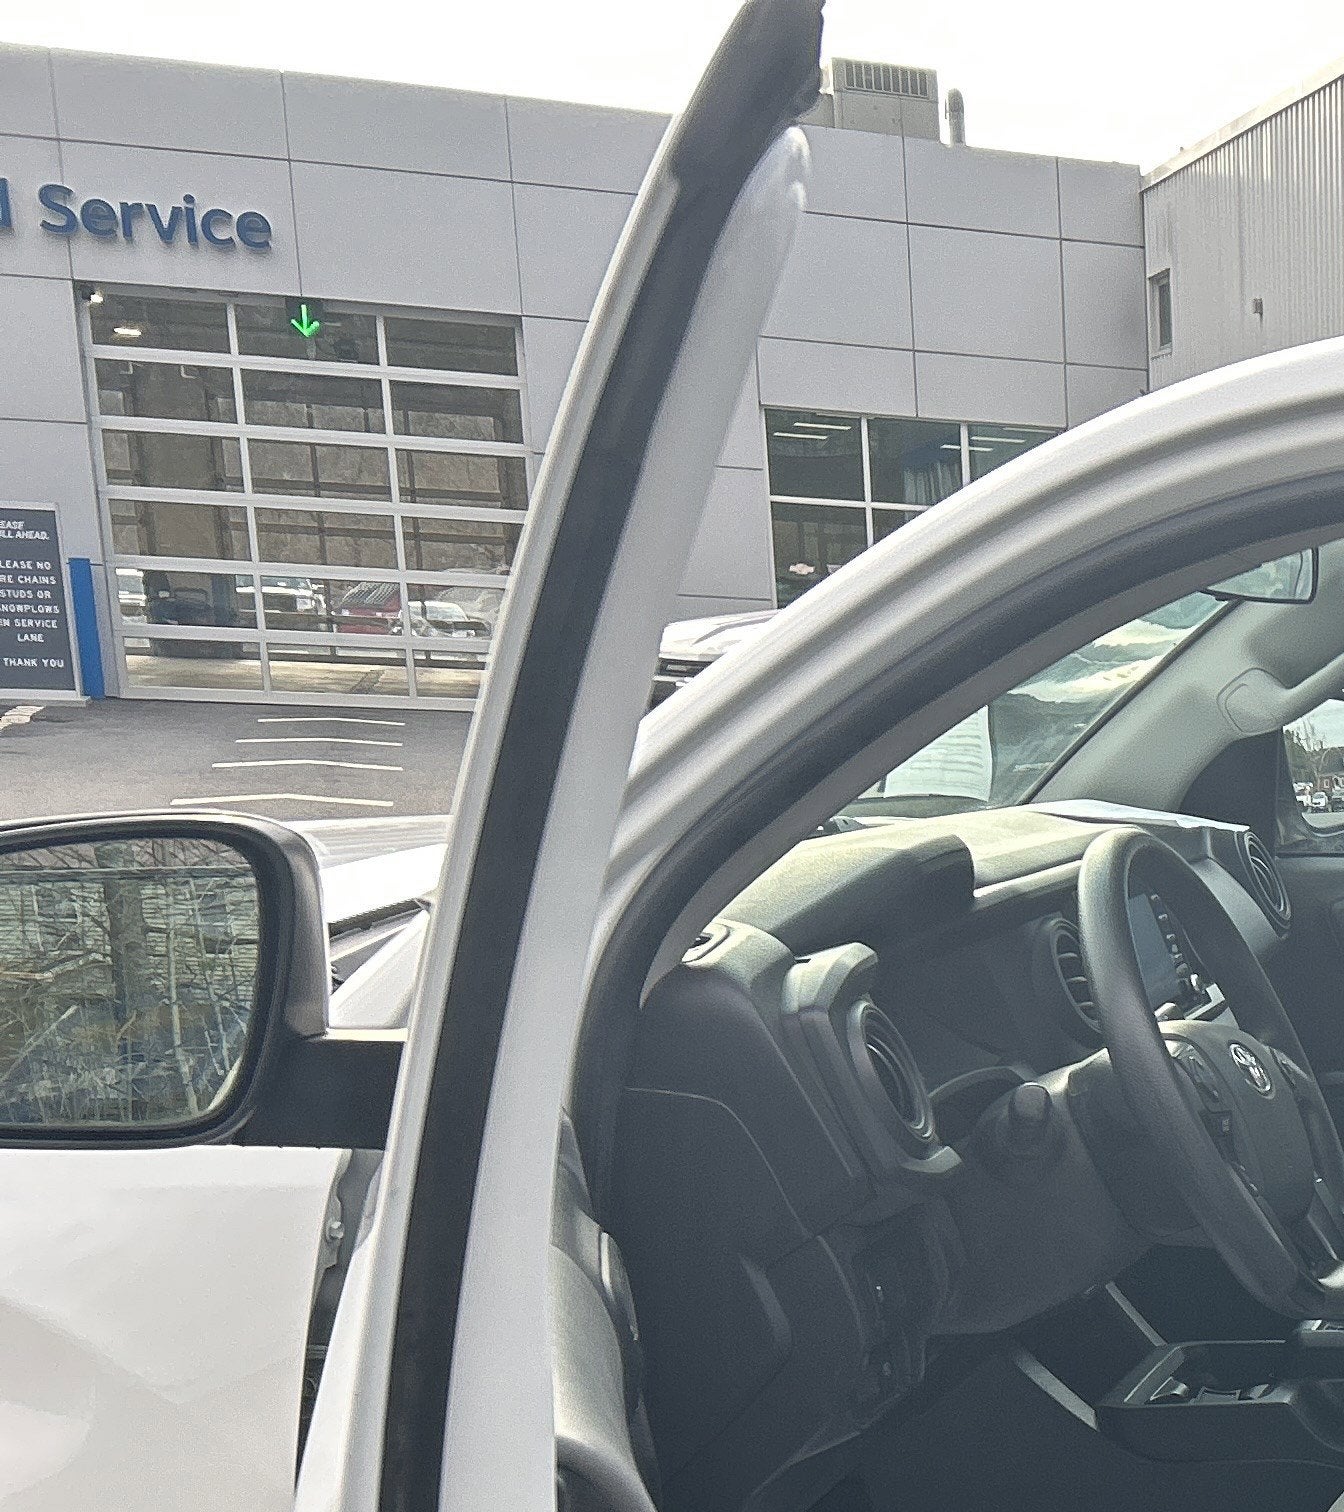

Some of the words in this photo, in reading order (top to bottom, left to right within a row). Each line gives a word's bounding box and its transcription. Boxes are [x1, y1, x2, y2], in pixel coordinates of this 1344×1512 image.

[38, 183, 273, 250] Service
[36, 561, 52, 571] NO
[17, 575, 57, 585] CHAINS
[36, 590, 52, 599] OR
[0, 604, 60, 614] NOWPLOWS
[14, 618, 58, 629] SERVICE
[17, 633, 45, 643] LANE
[3, 658, 38, 667] THANK
[42, 658, 65, 668] YOU
